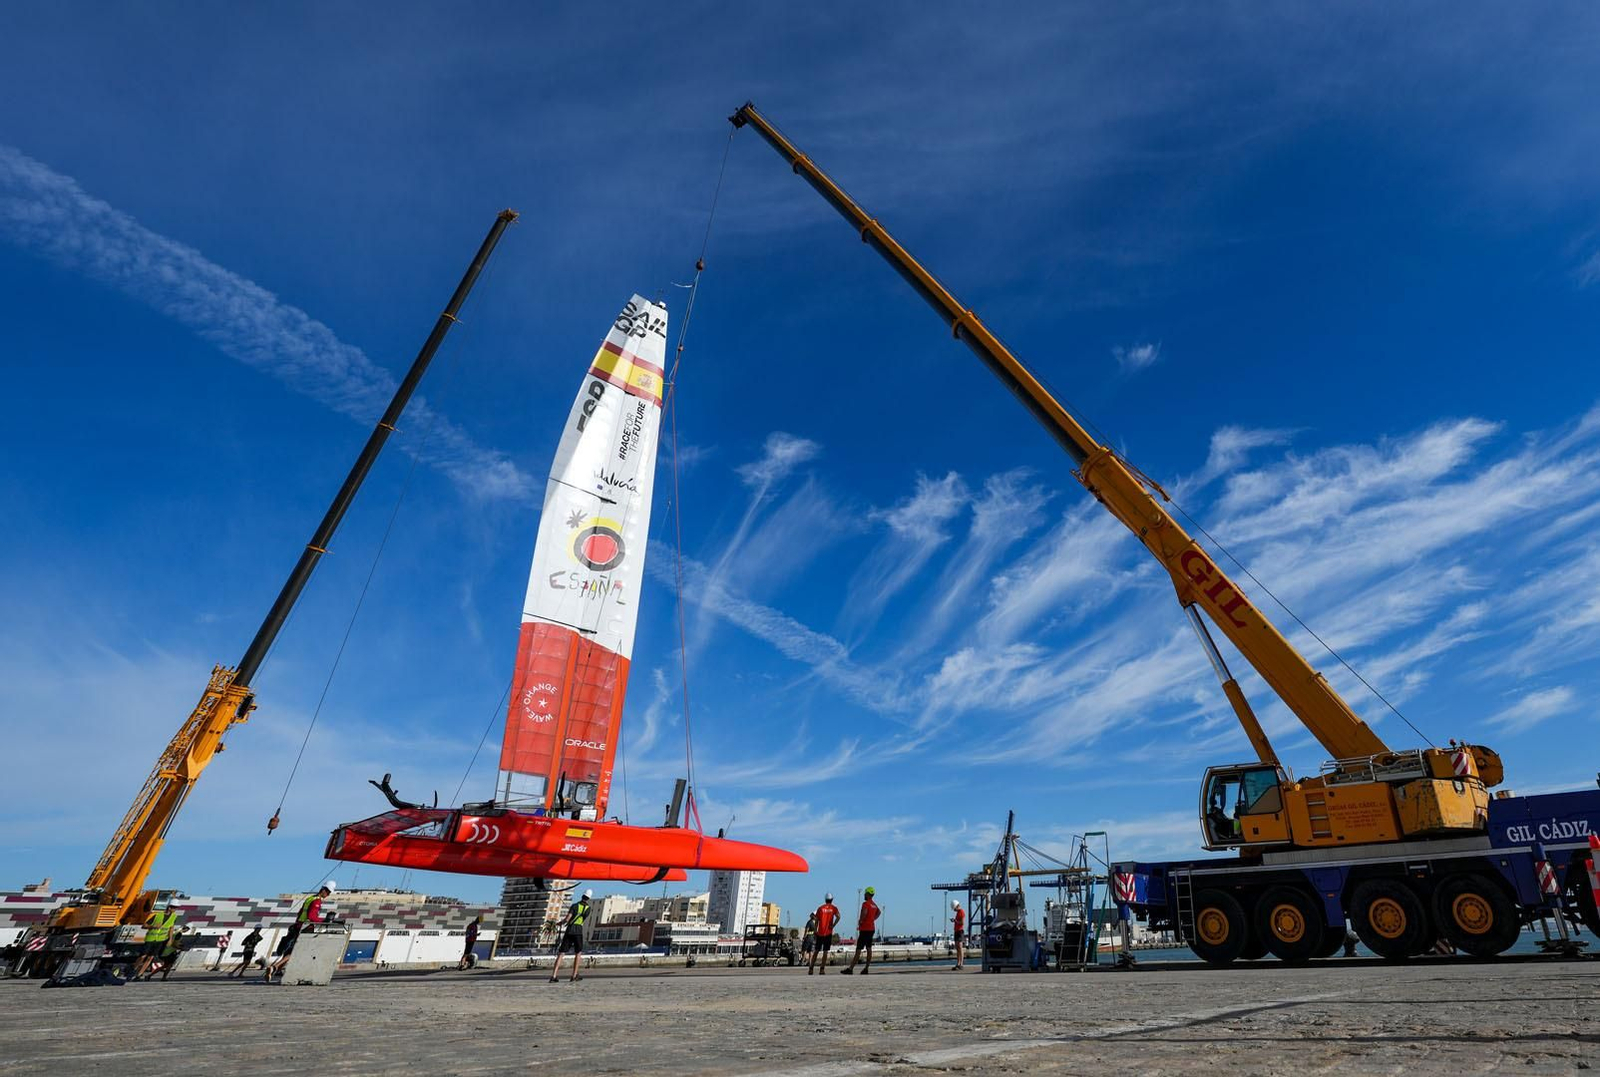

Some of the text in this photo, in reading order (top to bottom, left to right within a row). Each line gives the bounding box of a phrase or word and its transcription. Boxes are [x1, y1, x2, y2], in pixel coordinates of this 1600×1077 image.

[614, 315, 647, 339] GP
[621, 302, 666, 338] SAIL
[1181, 550, 1248, 628] GIL
[523, 683, 557, 705] CHANGE
[527, 711, 553, 723] WAVE
[565, 738, 606, 750] ORACLE
[1507, 818, 1591, 843] GIL CÁDIZ
